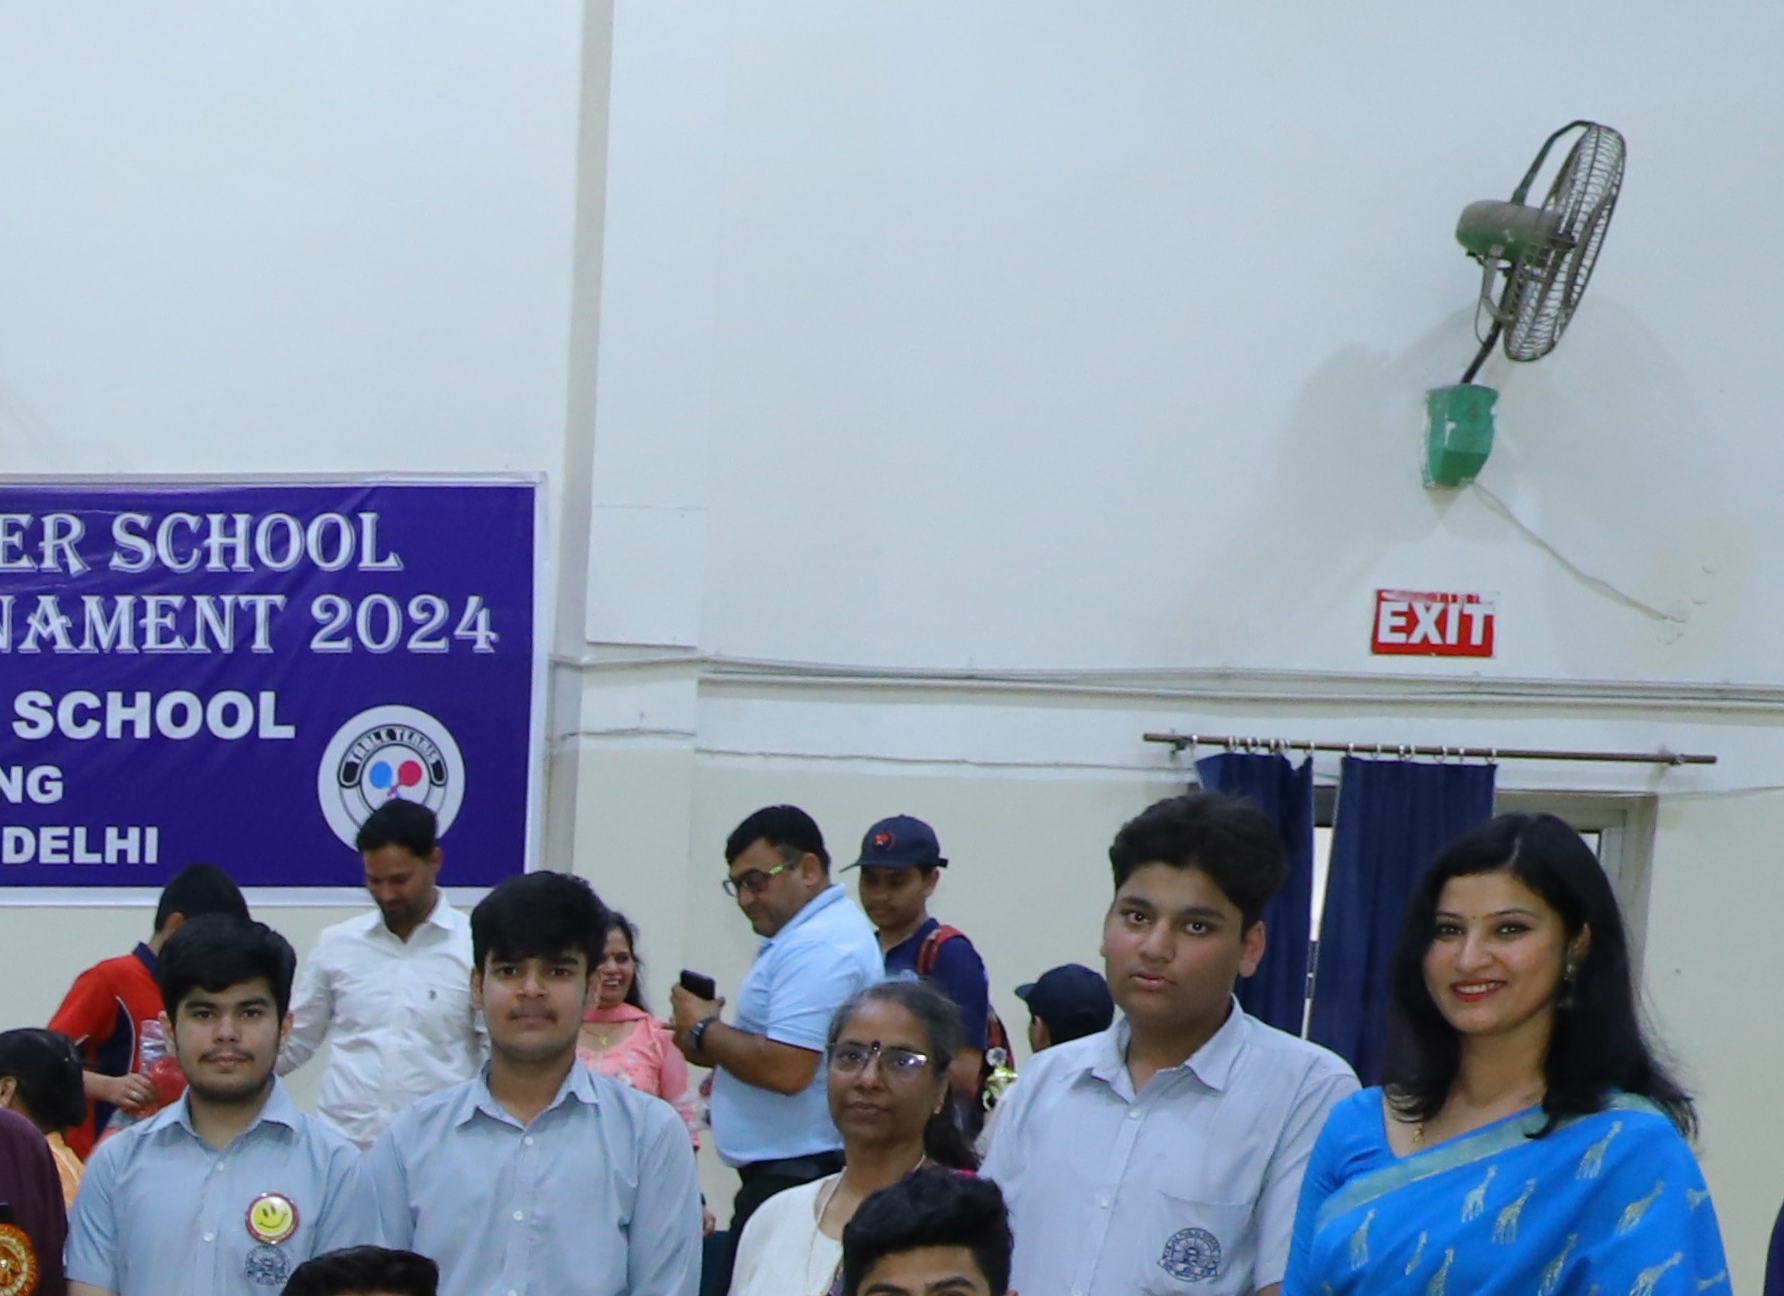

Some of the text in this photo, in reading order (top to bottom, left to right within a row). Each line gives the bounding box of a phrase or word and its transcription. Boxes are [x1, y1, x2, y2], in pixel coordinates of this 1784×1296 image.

[107, 511, 405, 574] SCHOOL
[308, 594, 501, 655] 2024
[1378, 601, 1493, 645] EXIT
[11, 691, 296, 741] SCHOOL
[1, 827, 159, 864] DELHI
